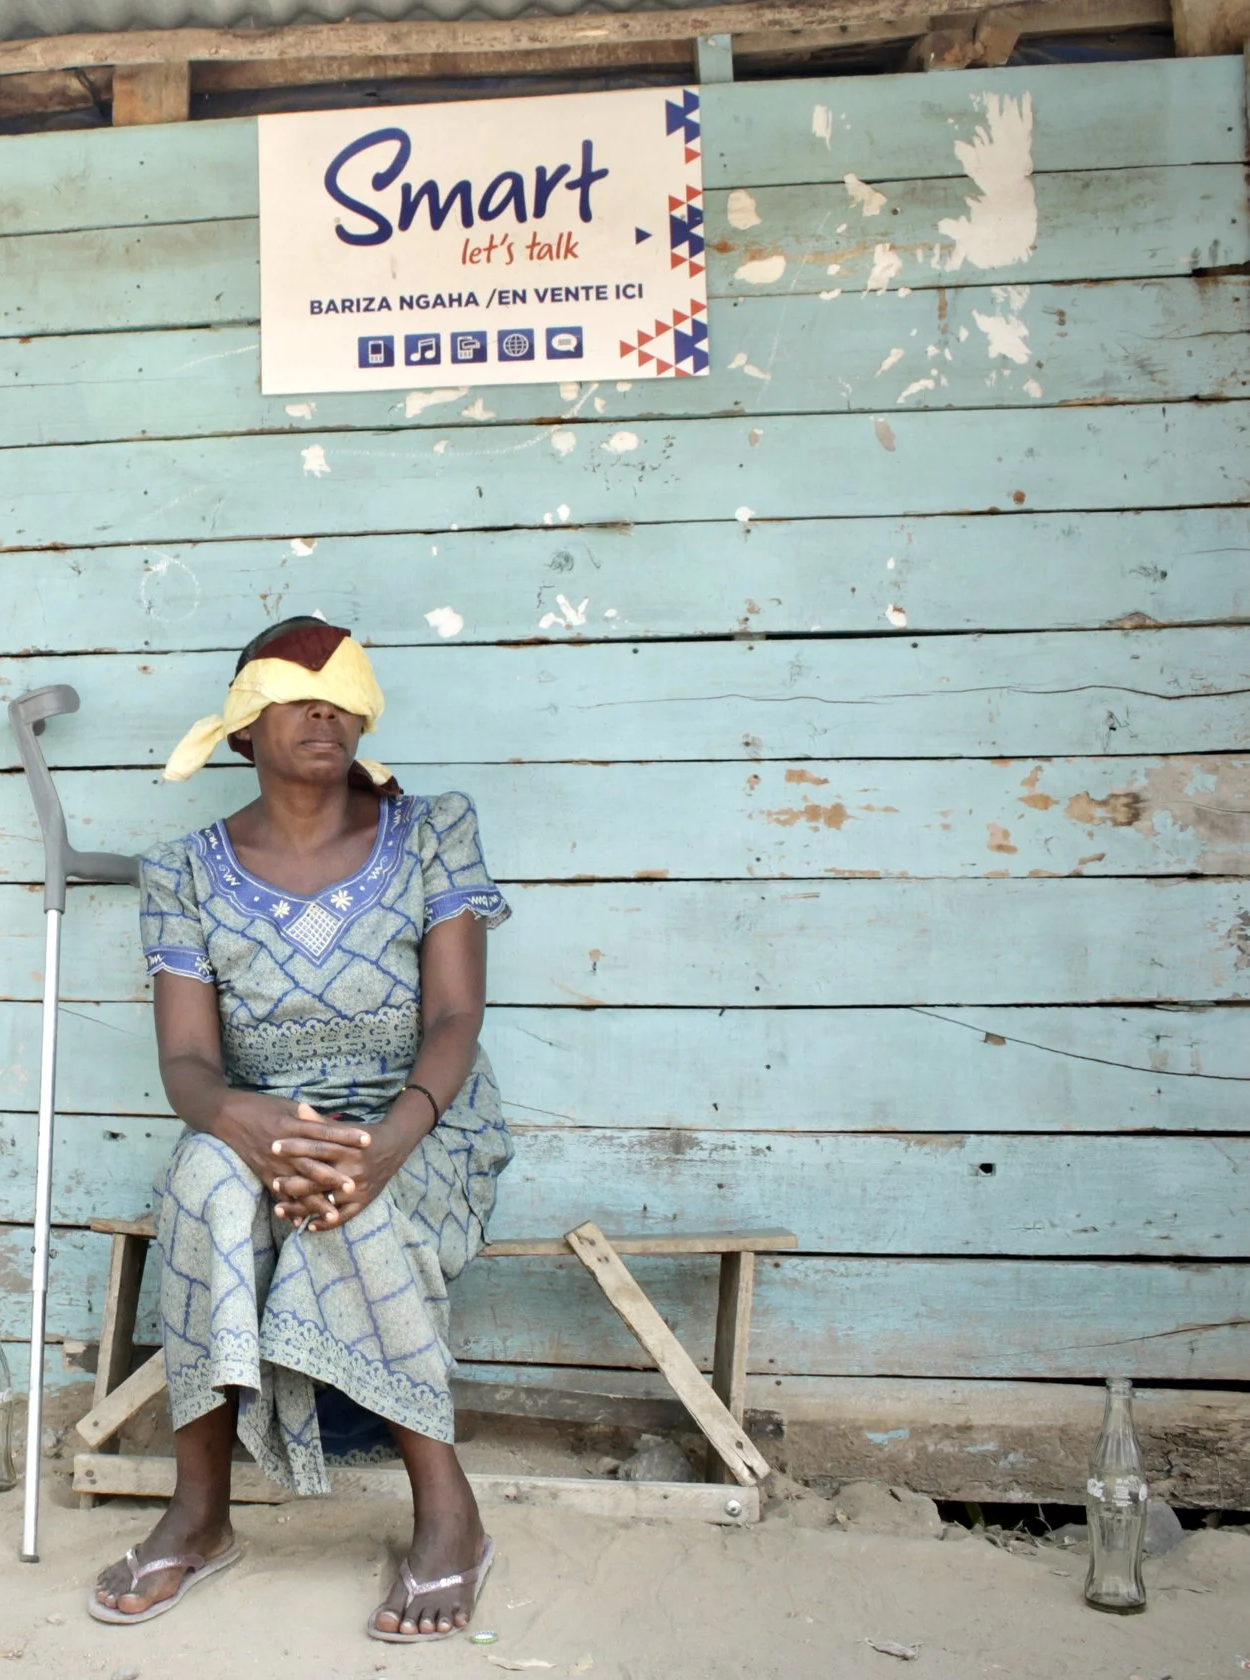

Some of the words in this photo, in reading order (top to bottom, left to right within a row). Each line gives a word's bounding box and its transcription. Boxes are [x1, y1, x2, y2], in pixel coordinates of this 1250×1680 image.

[324, 128, 609, 246] Smart
[461, 233, 515, 266] let's
[526, 231, 578, 263] talk
[310, 297, 392, 315] BARIZA
[400, 291, 479, 310] NGAHA
[534, 284, 609, 304] VENTE
[615, 283, 643, 300] ICI
